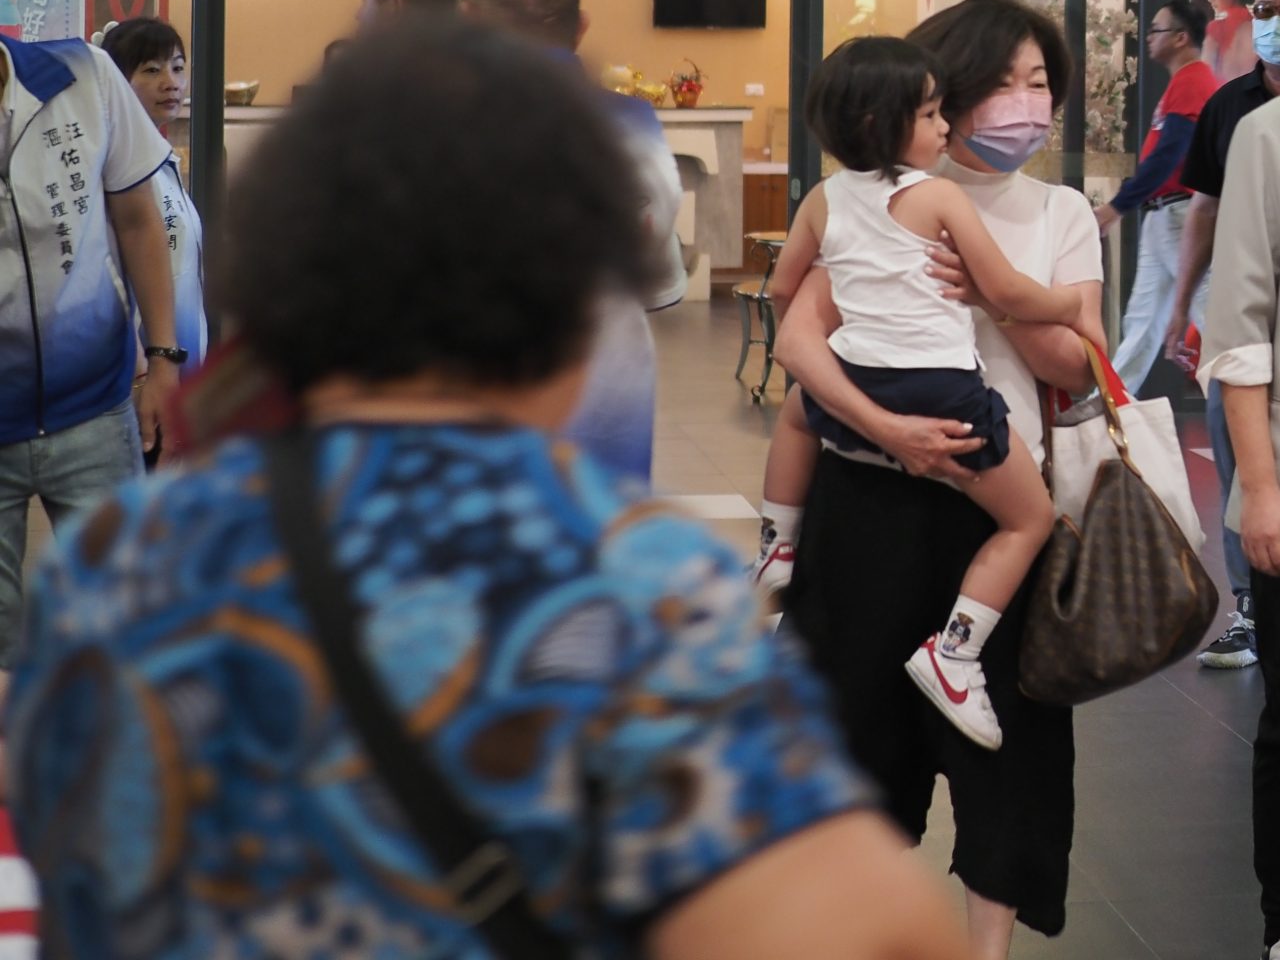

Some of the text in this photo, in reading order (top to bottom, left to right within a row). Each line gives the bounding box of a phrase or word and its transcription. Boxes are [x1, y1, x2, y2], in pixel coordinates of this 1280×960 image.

[46, 182, 74, 276] 管理委員會
